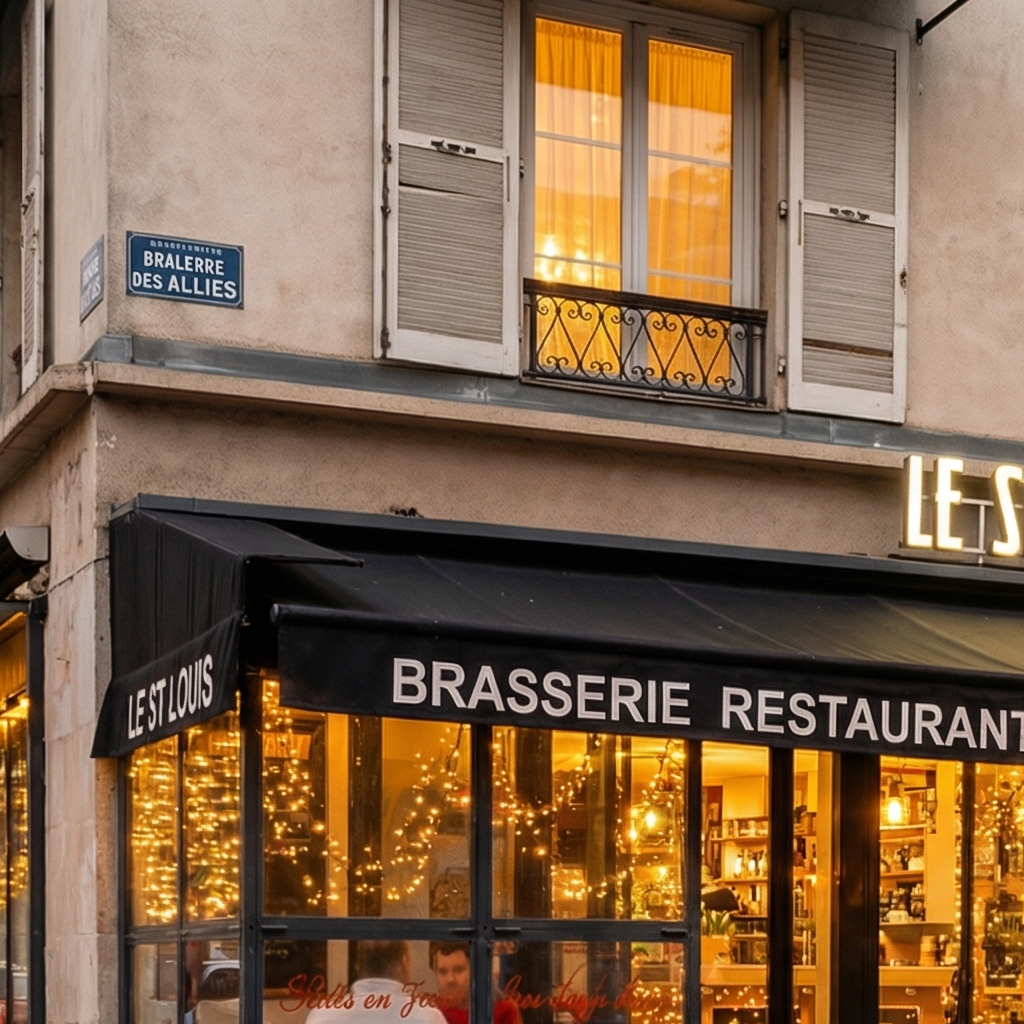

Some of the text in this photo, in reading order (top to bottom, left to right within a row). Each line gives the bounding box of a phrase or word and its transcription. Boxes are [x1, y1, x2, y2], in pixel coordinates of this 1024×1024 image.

[132, 271, 237, 299] DES ALLIES
[143, 250, 225, 276] BRALERRE
[904, 455, 964, 550] LE
[128, 653, 213, 740] LE ST LOUIS
[392, 657, 691, 726] BRASSERIE
